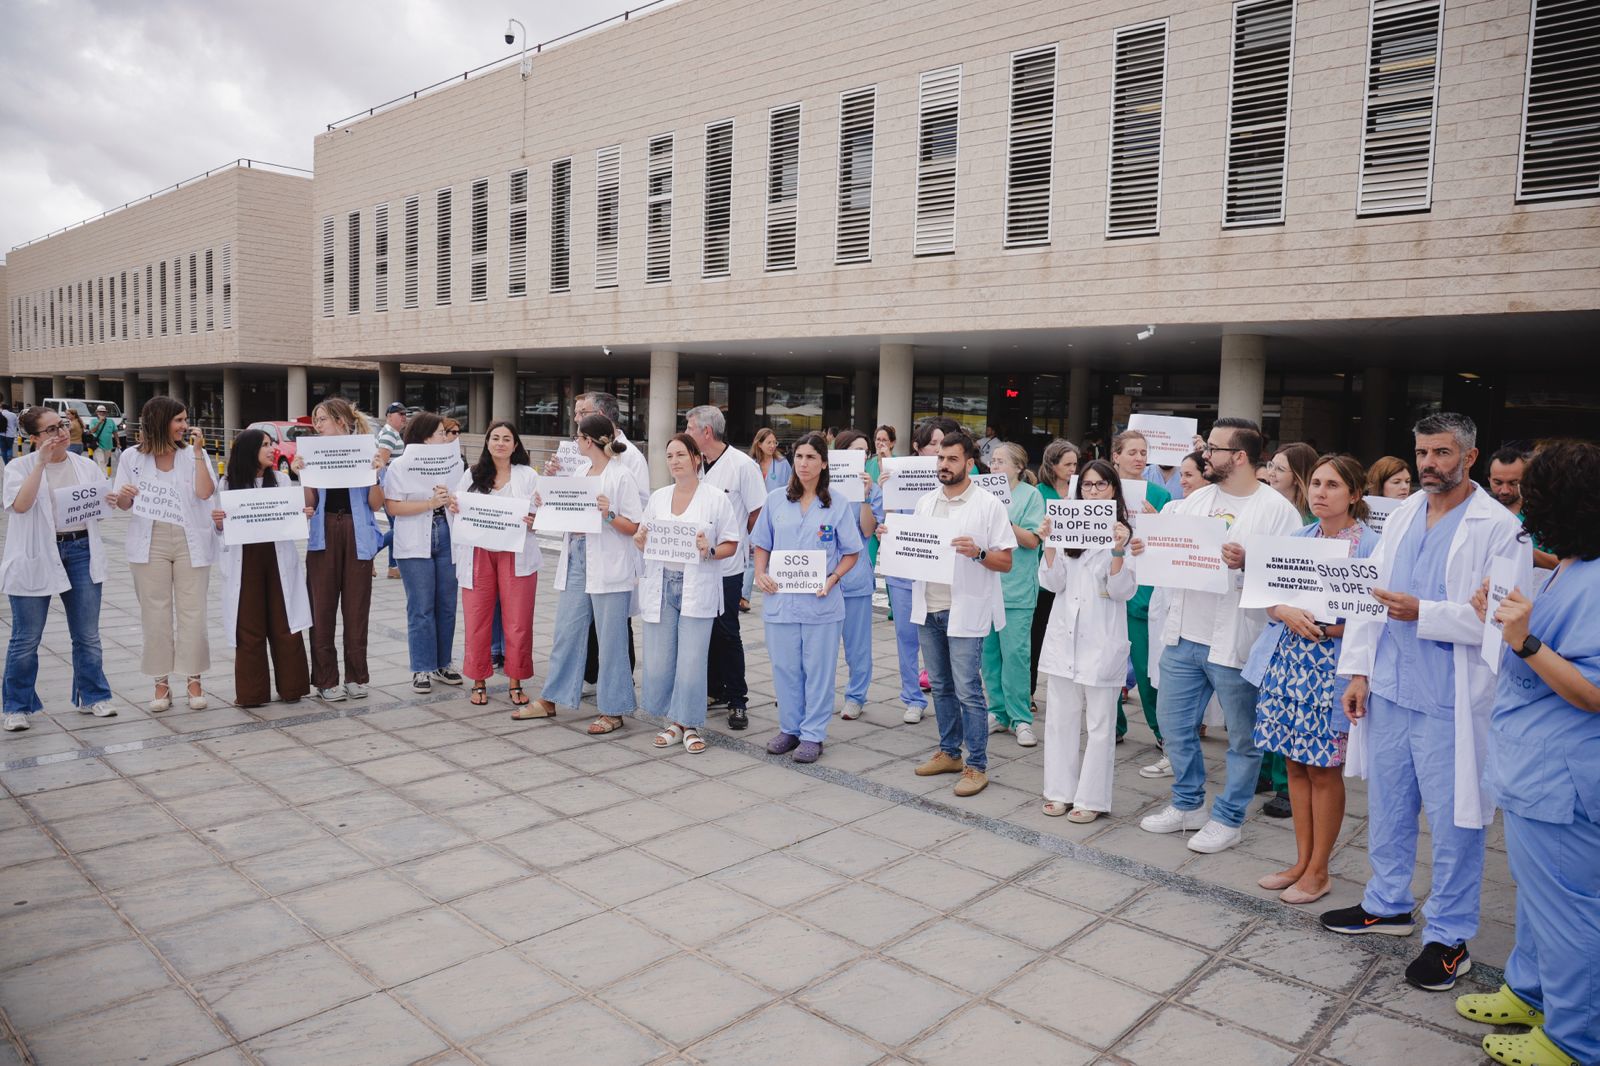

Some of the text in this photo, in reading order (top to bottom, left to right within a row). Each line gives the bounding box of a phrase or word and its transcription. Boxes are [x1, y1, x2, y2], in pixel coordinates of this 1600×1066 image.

[982, 475, 1007, 487] SCS
[139, 481, 167, 496] Stop
[72, 488, 97, 501] SCS
[83, 500, 100, 510] deja
[141, 495, 150, 503] la
[153, 497, 173, 507] OPE
[1048, 504, 1080, 519] Stop
[1083, 504, 1113, 516] SCS
[65, 510, 101, 524] sin plaza
[646, 522, 696, 536] Stop SCS
[1054, 520, 1108, 530] la OPE no
[660, 537, 679, 546] OPE
[895, 536, 941, 545] NOMBRAMIENTOS
[1049, 534, 1062, 542] es
[1080, 534, 1113, 545] juego
[1147, 542, 1200, 550] NOMBRAMIENTOS
[671, 549, 696, 559] juego
[895, 551, 939, 560] ENFRENTAMIENTO
[784, 555, 809, 566] SCS
[1171, 560, 1220, 570] ENTENDIMIENTO
[1197, 556, 1221, 564] ESPERES
[776, 570, 810, 579] engaña
[1317, 564, 1379, 580] Stop SCS
[786, 581, 824, 589] médicos
[1268, 582, 1324, 592] ENFRENTAMIENTO
[1330, 582, 1373, 595] la OPE n
[1328, 600, 1385, 616] es un juego
